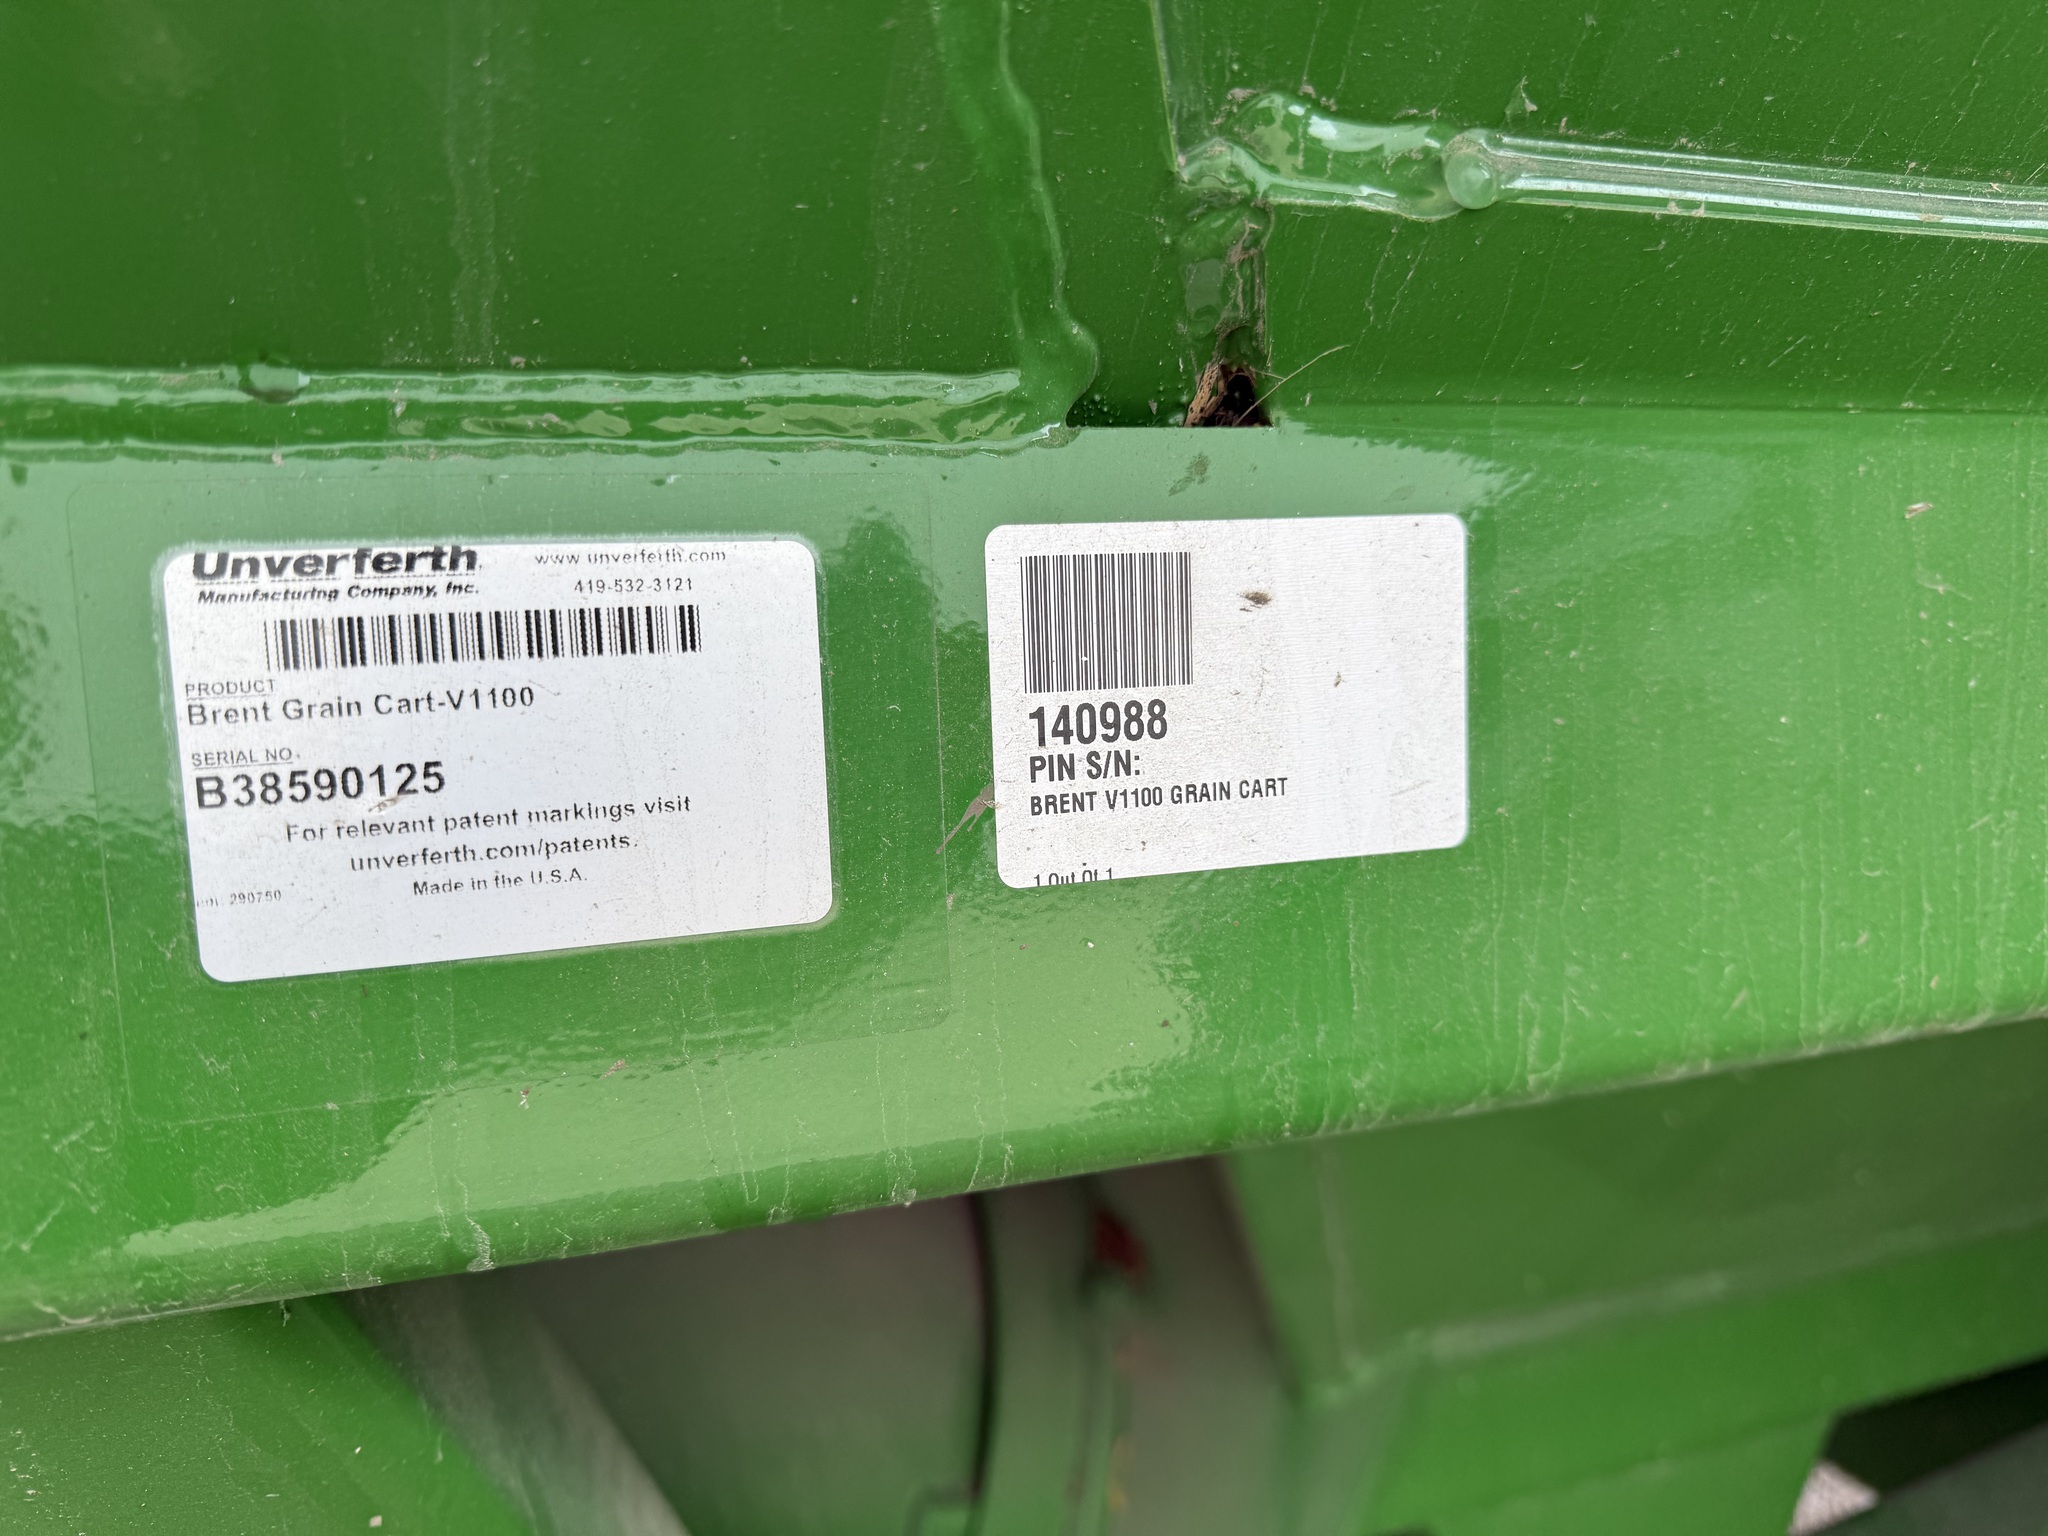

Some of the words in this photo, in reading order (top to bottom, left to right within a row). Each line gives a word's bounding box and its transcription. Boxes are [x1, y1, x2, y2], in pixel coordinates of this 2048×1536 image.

[192, 545, 478, 581] Unverferth
[197, 585, 340, 605] Manufacturing
[347, 582, 438, 600] Company,
[446, 581, 480, 596] Inc.
[574, 577, 693, 594] 419-532-3121
[185, 679, 276, 697] PRODUCT
[188, 701, 272, 726] Brent
[283, 696, 363, 720] Grain
[374, 686, 535, 716] Cart-V1100
[1028, 698, 1168, 748] 140988
[192, 749, 259, 768] SERIAL
[266, 747, 301, 762] NO.
[1029, 753, 1076, 783] PIN
[1086, 749, 1141, 780] S/N:
[195, 760, 446, 809] B38590125
[1030, 790, 1098, 816] BRENT
[1104, 786, 1163, 811] V1100
[1170, 780, 1231, 804] GRAIN
[1238, 777, 1289, 800] CART
[286, 823, 325, 843] For
[337, 814, 435, 840] relevant
[444, 808, 519, 836] patent
[528, 801, 636, 823] markings
[643, 795, 692, 816] visit
[350, 834, 639, 873] unverferth.com/patents.
[229, 889, 282, 906] 290750
[413, 878, 464, 896] Made
[470, 877, 488, 891] in
[494, 873, 524, 889] the
[530, 867, 588, 885] U.S.A.
